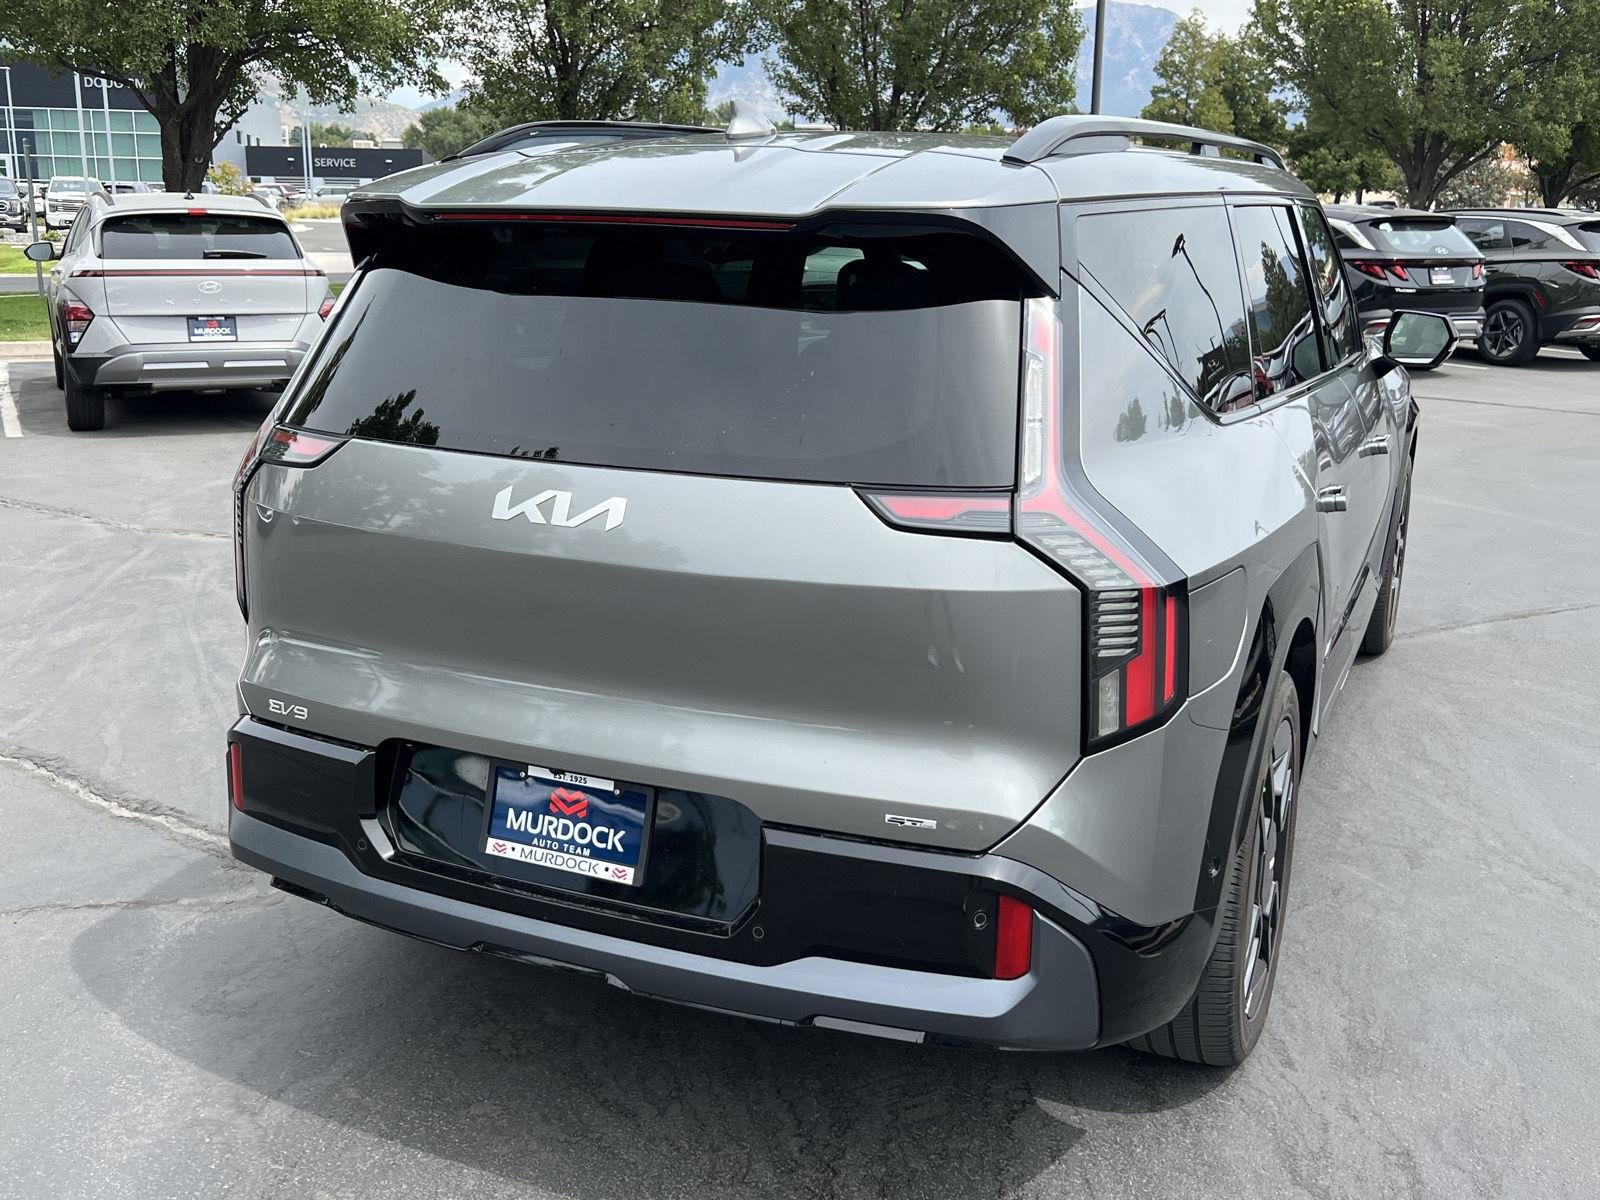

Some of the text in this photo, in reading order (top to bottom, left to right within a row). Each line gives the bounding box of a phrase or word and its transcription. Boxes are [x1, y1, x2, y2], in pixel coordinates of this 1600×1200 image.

[314, 157, 357, 168] SERVICE
[193, 327, 232, 335] MURDOCK
[491, 485, 628, 532] KIA
[268, 698, 308, 720] EV9
[570, 774, 588, 785] 1925
[506, 807, 626, 853] MURDOCK
[531, 837, 591, 857] AUTO TEAM
[519, 847, 600, 875] MURDOCK
